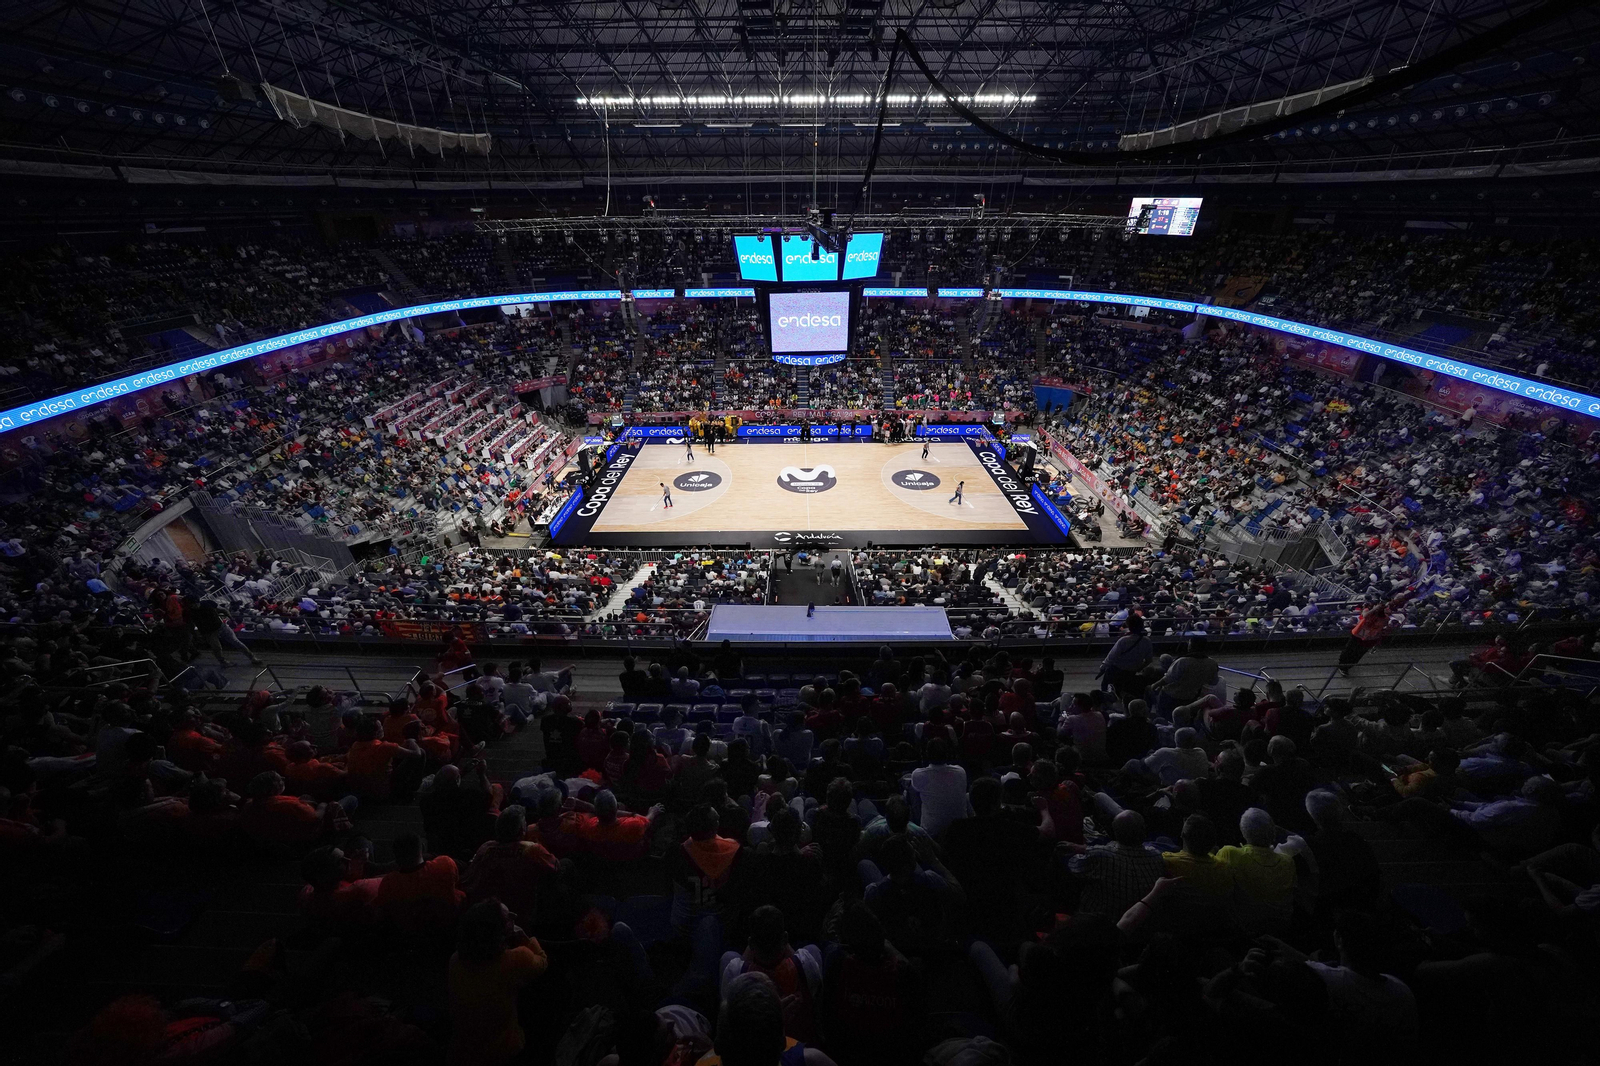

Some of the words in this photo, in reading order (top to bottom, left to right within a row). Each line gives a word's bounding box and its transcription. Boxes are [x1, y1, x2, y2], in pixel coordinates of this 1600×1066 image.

[740, 252, 773, 264] endesa
[786, 252, 835, 264] endsa
[848, 250, 878, 262] endesa
[1074, 293, 1100, 301] endesa
[1104, 295, 1131, 303] endesa
[1135, 298, 1162, 307] endesa
[1165, 301, 1192, 311] endesa
[778, 313, 841, 327] endesa
[20, 398, 76, 421] endesa
[81, 382, 129, 403] endesa
[133, 369, 175, 387] endesa
[180, 357, 217, 374] endesa
[220, 347, 254, 362] endesa
[257, 339, 288, 352] endesa
[290, 330, 318, 343] endesa
[320, 324, 347, 336] endesa
[350, 317, 374, 328] endesa
[376, 311, 401, 321] endesa
[404, 306, 430, 316] endesa
[433, 302, 460, 312] endesa
[463, 299, 490, 308] endesa
[494, 297, 520, 305] endesa
[776, 355, 810, 365] endesa
[1196, 305, 1222, 316] endesa
[1225, 310, 1250, 321] endesa
[1253, 316, 1279, 328] endesa
[1282, 323, 1310, 335] endesa
[1312, 330, 1343, 343] endesa
[1348, 338, 1381, 352] endesa
[1384, 347, 1422, 364] endesa
[1426, 358, 1468, 376] endesa
[1472, 371, 1520, 391] endesa
[1526, 385, 1581, 408] endesa
[609, 454, 635, 469] Rey
[980, 452, 1007, 475] Copa
[601, 470, 622, 485] del
[998, 476, 1024, 492] del
[577, 486, 612, 516] Copa
[1010, 494, 1038, 515] Rey
